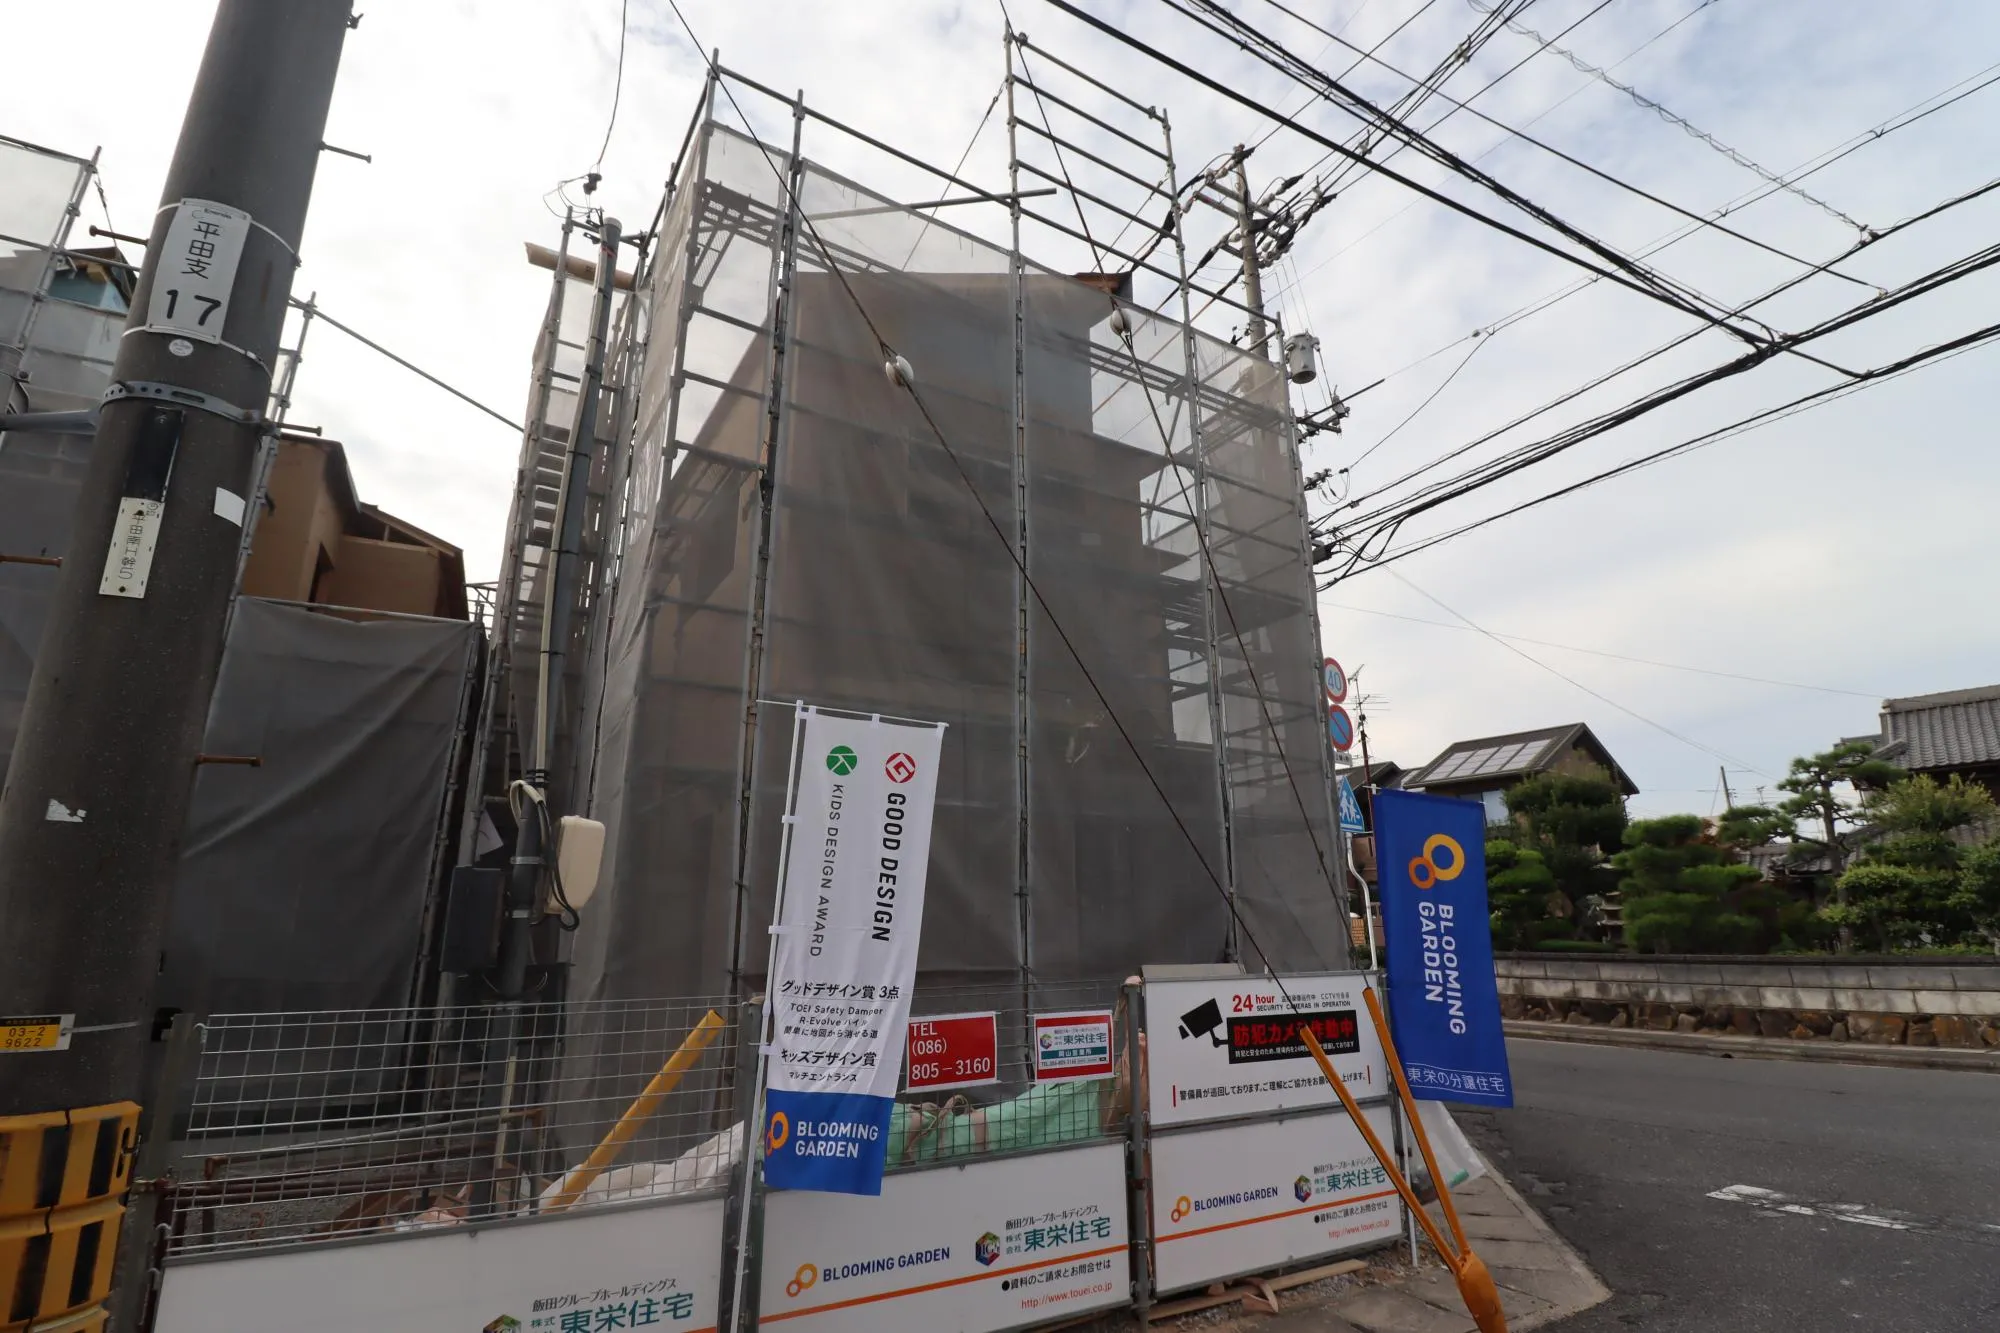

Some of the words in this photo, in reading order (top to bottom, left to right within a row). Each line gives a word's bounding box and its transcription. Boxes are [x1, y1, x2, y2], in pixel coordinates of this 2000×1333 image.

[181, 221, 220, 279] 平田支
[166, 289, 222, 327] 17
[1328, 671, 1342, 690] 40
[830, 784, 845, 820] KIDS
[882, 792, 907, 851] GOOD
[820, 827, 839, 889] DESIGN
[871, 857, 899, 941] DESIGN
[810, 895, 829, 957] AWARD
[1418, 901, 1444, 1003] GARDEN
[1438, 903, 1466, 1035] BLOOMING
[781, 980, 875, 999] グッドデザイン賞
[878, 986, 900, 999] 3点
[790, 1003, 811, 1012] TOEI
[814, 1005, 845, 1016] Safety
[849, 1007, 884, 1016] Damper
[1232, 994, 1254, 1012] 24
[1255, 994, 1275, 1004] hour
[1256, 1004, 1283, 1012] SECURITY
[1322, 1000, 1351, 1008] OPERATION
[799, 1016, 842, 1026] R-Evolve
[911, 1022, 937, 1037] TEL
[1233, 1017, 1354, 1047] 防犯カメ作動中
[6, 1037, 42, 1048] 9622
[912, 1037, 947, 1056] (086)
[1063, 1032, 1107, 1045] 東栄住宅
[781, 1048, 877, 1067] キッズデザイン賞
[788, 1071, 857, 1082] マルチエントランス
[1407, 1066, 1504, 1093] 東栄の分譲住宅
[796, 1120, 879, 1141] BLOOMING
[795, 1140, 860, 1158] GARDEN
[1327, 1166, 1386, 1193] 東栄住宅
[1194, 1193, 1242, 1212] BLOOMING
[1243, 1186, 1278, 1203] GARDEN
[1005, 1204, 1099, 1230] 飯田グループホールディングス
[1024, 1216, 1111, 1253] 東栄住宅
[823, 1253, 895, 1283] BLOOMING
[898, 1247, 951, 1269] GARDEN
[532, 1279, 677, 1313] 飯田グループホールディングス
[1021, 1281, 1113, 1310] http://www.touei.co.jp
[530, 1316, 556, 1328] 株式
[559, 1292, 694, 1333] 東栄住宅
